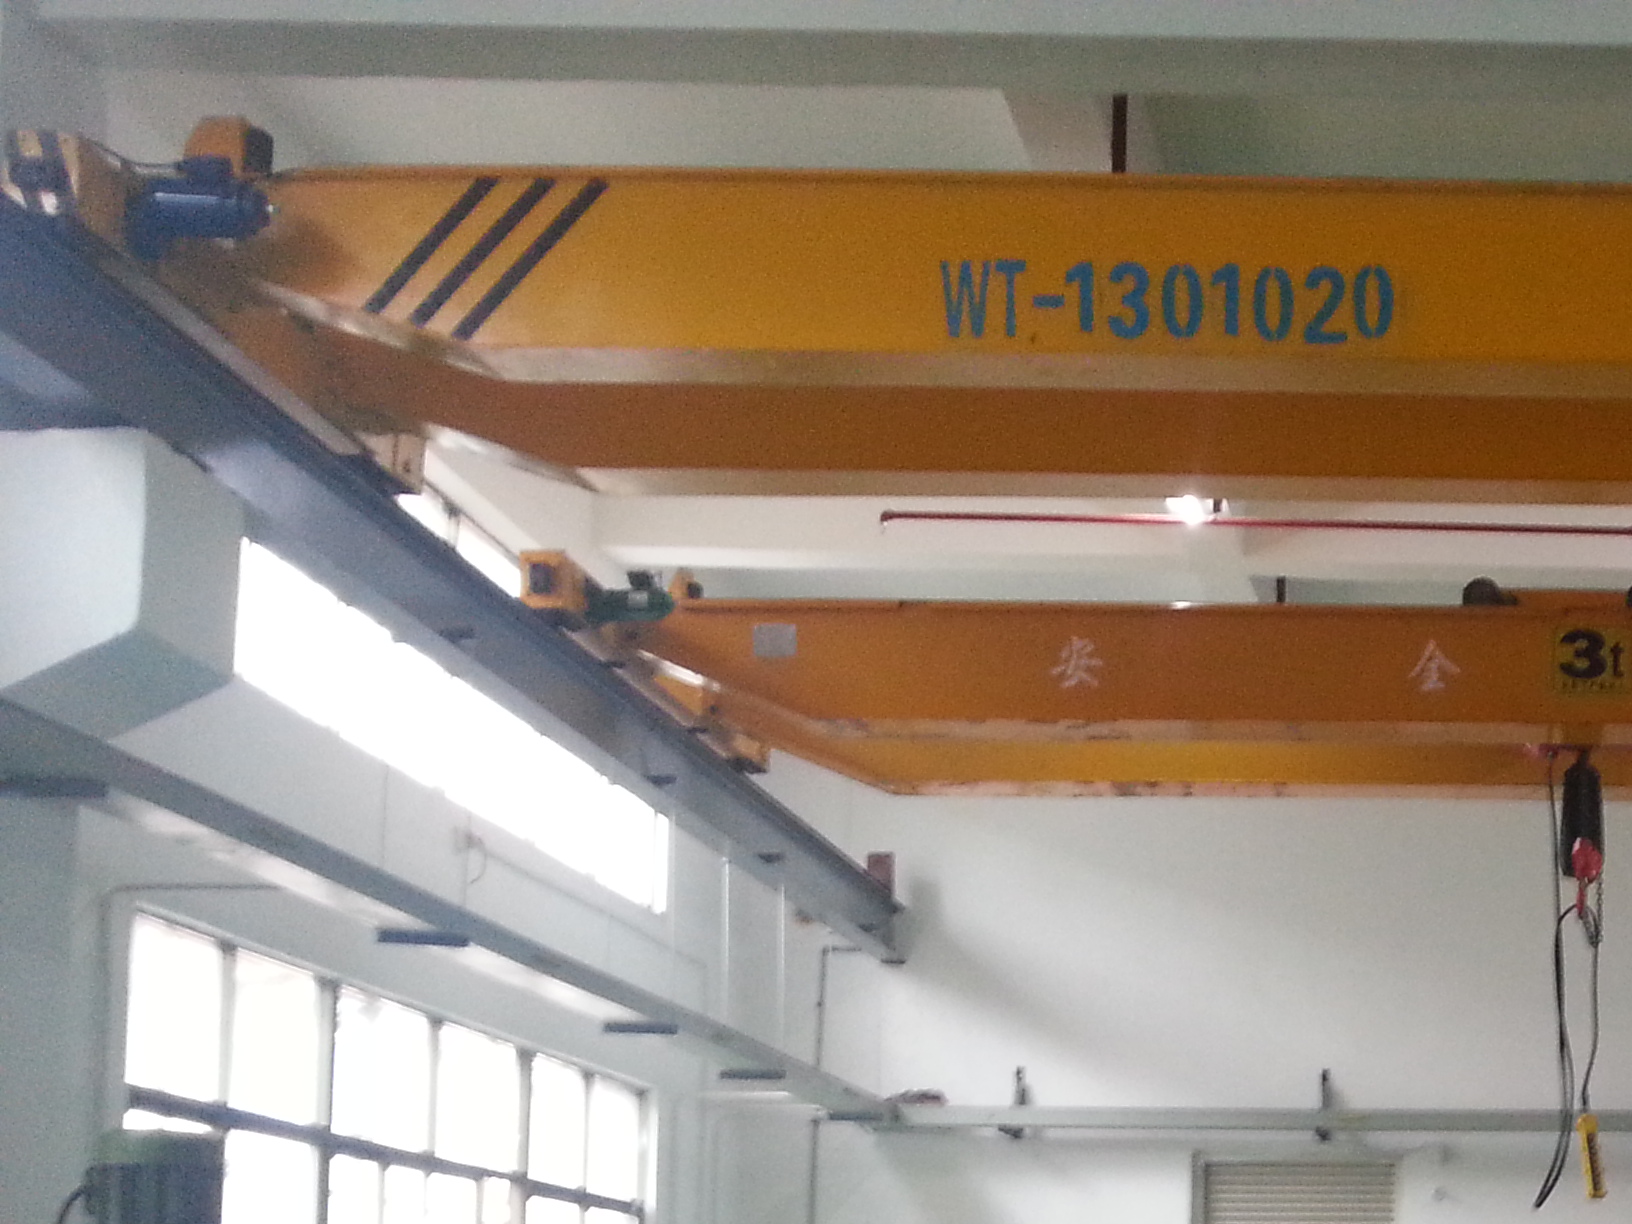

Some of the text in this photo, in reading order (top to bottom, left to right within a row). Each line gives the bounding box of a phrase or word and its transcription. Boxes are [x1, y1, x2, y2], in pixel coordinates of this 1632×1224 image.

[939, 258, 1395, 345] WT-1301020
[1408, 640, 1461, 690] 全
[1559, 628, 1625, 679] 3t
